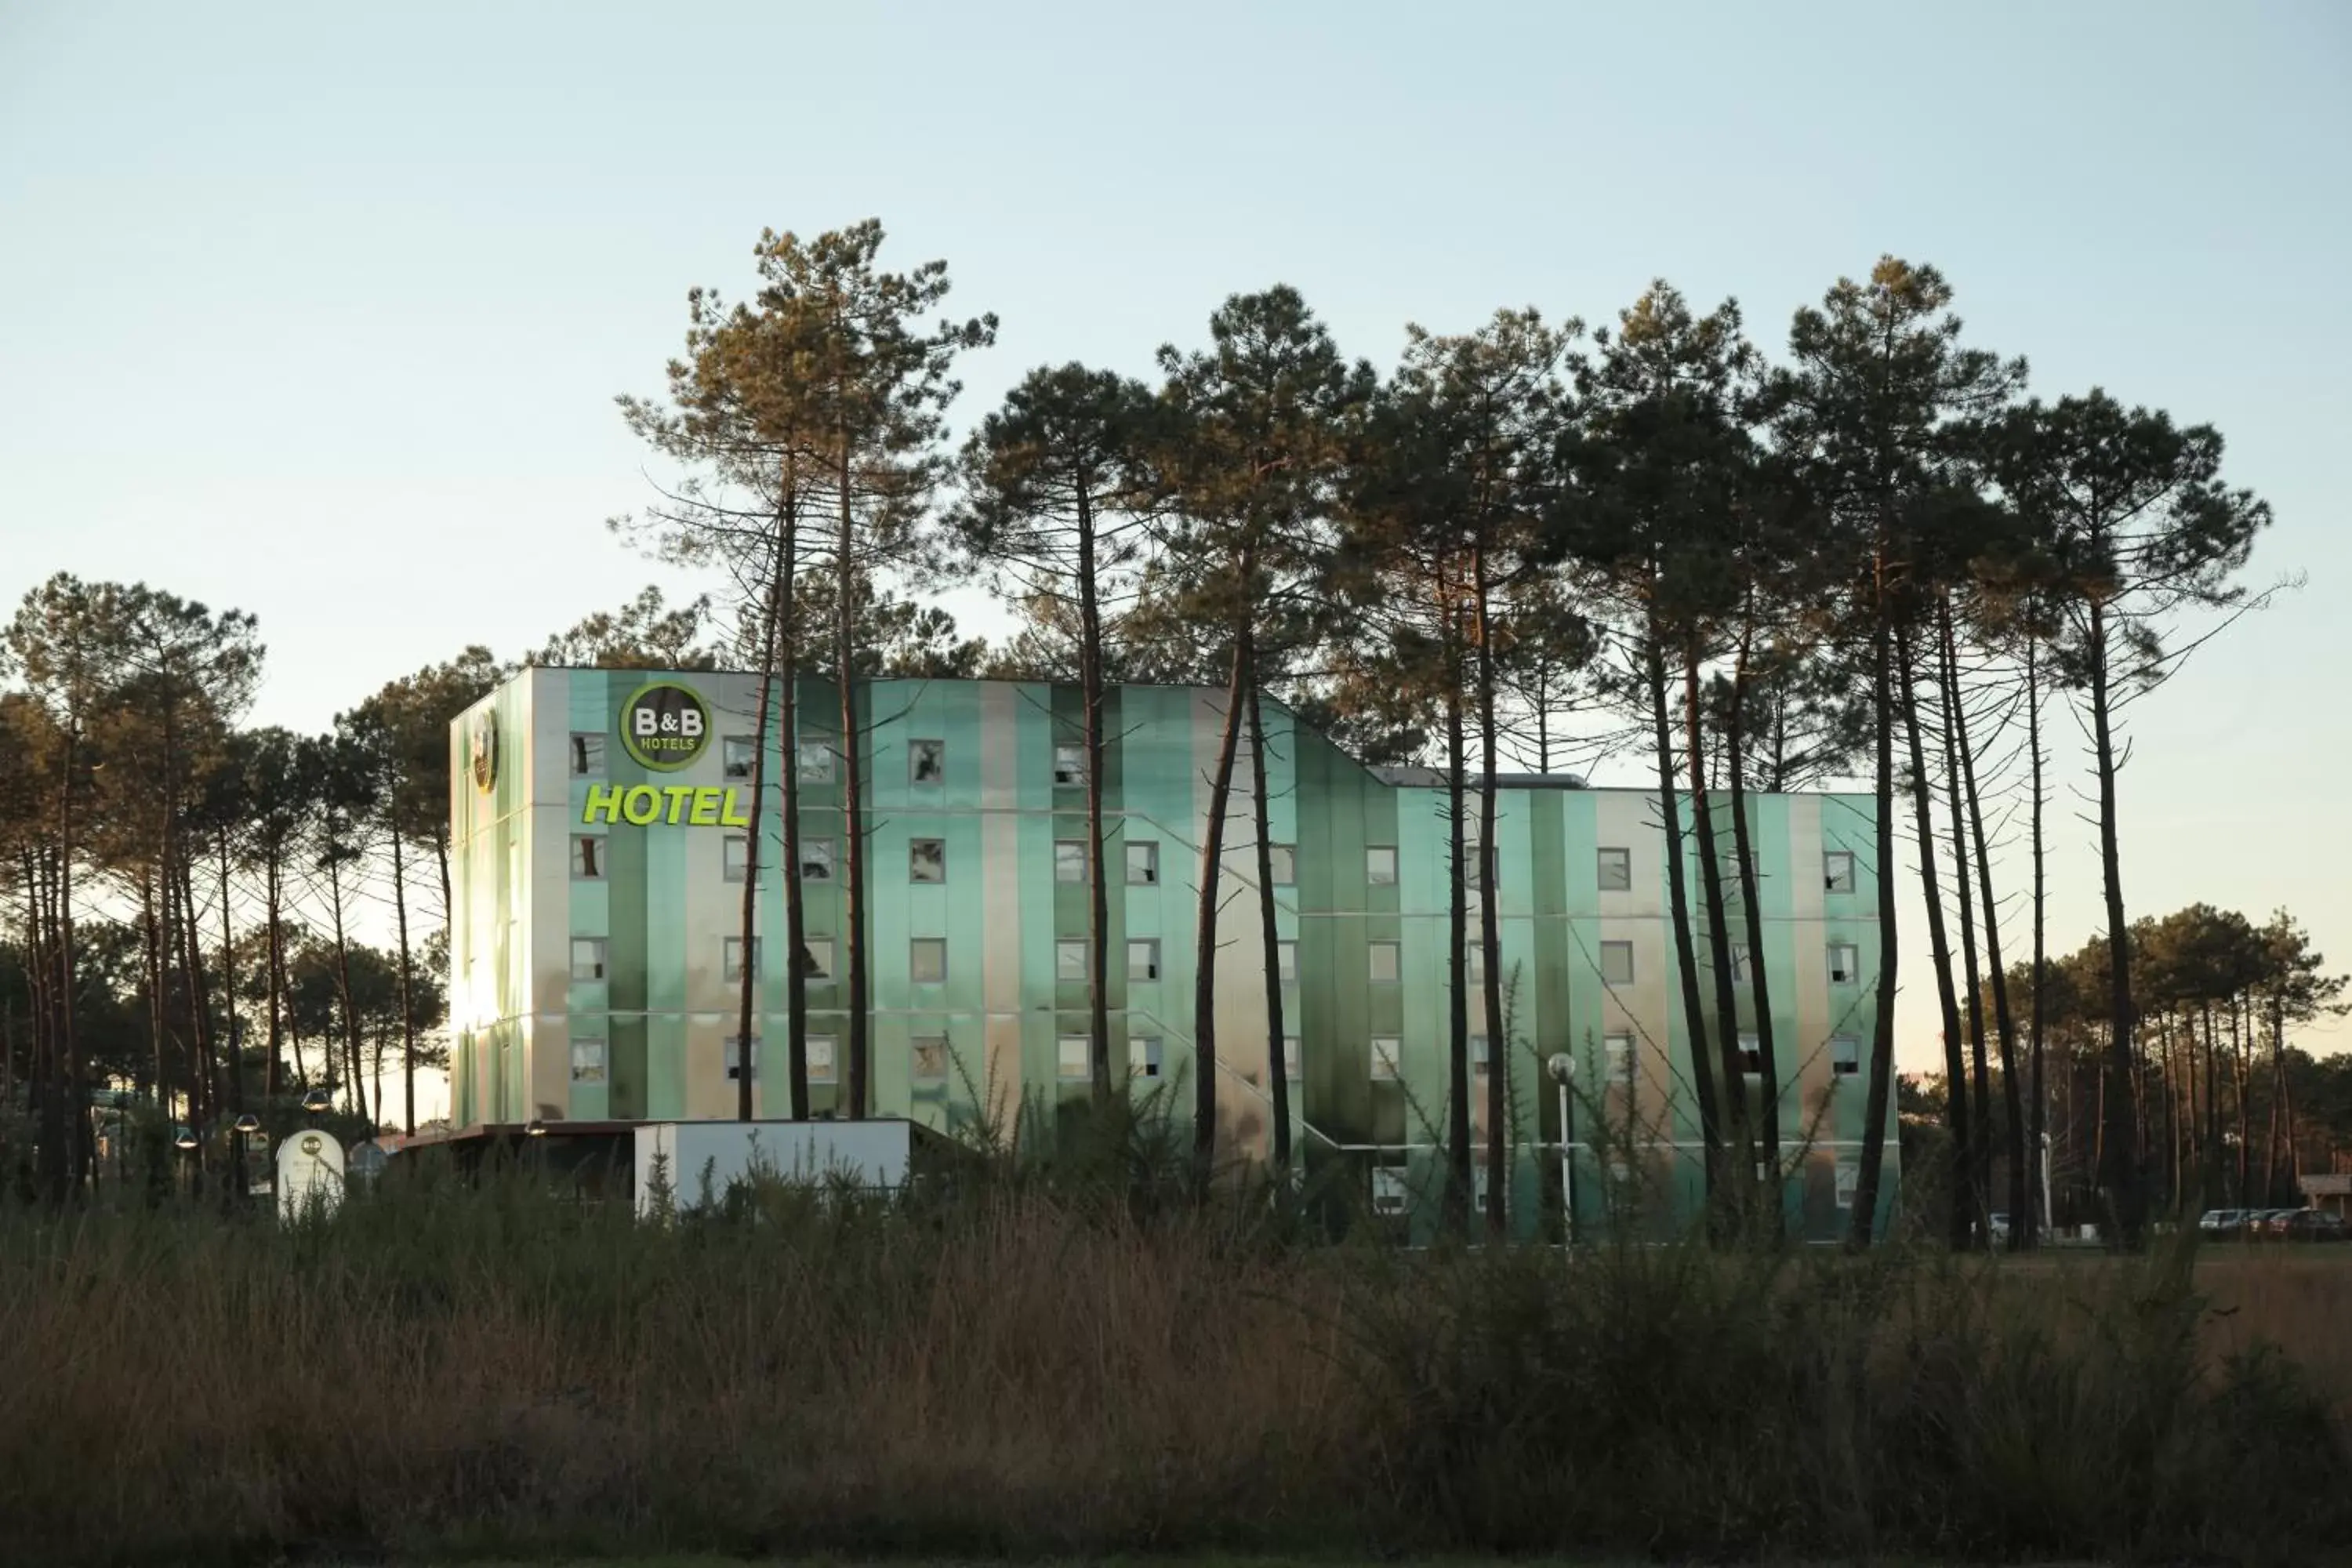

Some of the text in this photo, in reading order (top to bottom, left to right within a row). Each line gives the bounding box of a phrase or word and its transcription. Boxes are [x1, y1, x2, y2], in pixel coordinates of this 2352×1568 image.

[635, 707, 704, 736] B&B
[640, 737, 695, 750] HOTELS
[583, 784, 750, 826] HOTEL
